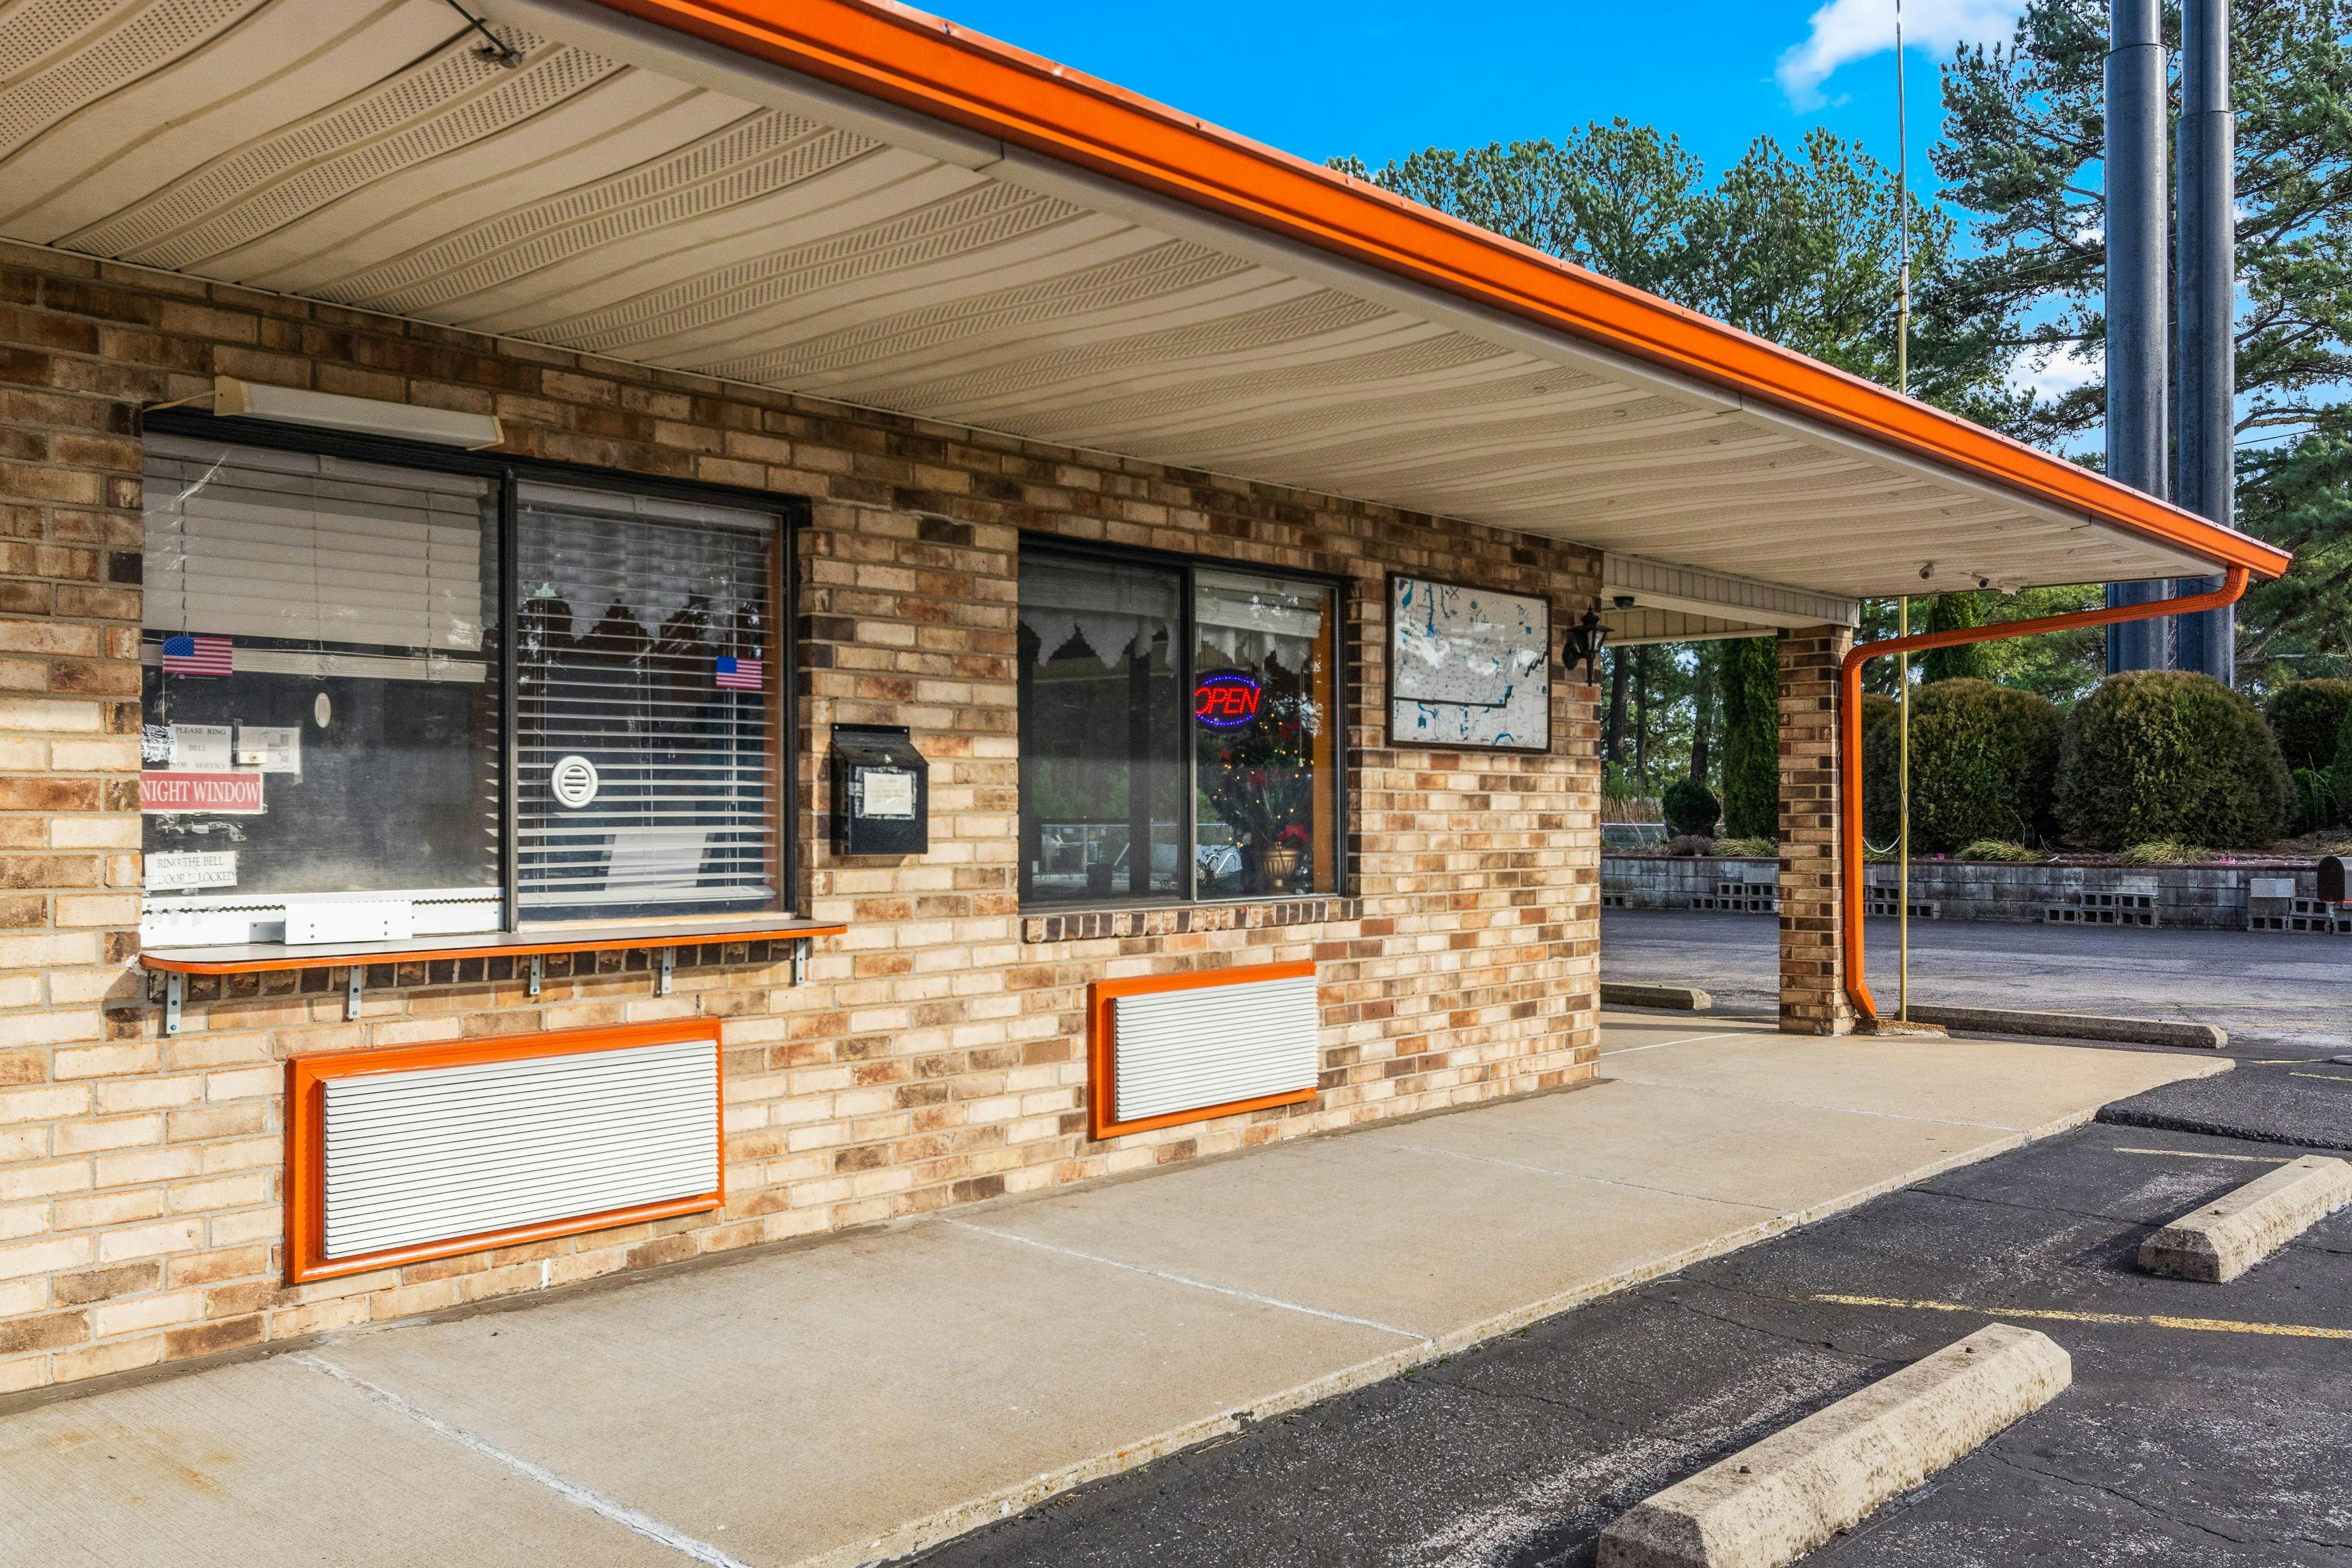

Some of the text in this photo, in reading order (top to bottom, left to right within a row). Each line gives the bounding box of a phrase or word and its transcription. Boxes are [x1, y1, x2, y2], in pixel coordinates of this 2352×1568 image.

[1195, 687, 1261, 714] OPEN
[142, 781, 260, 802] NIGHT WINDOW
[157, 855, 225, 868] RING THE BELL
[198, 870, 235, 883] LOCKED
